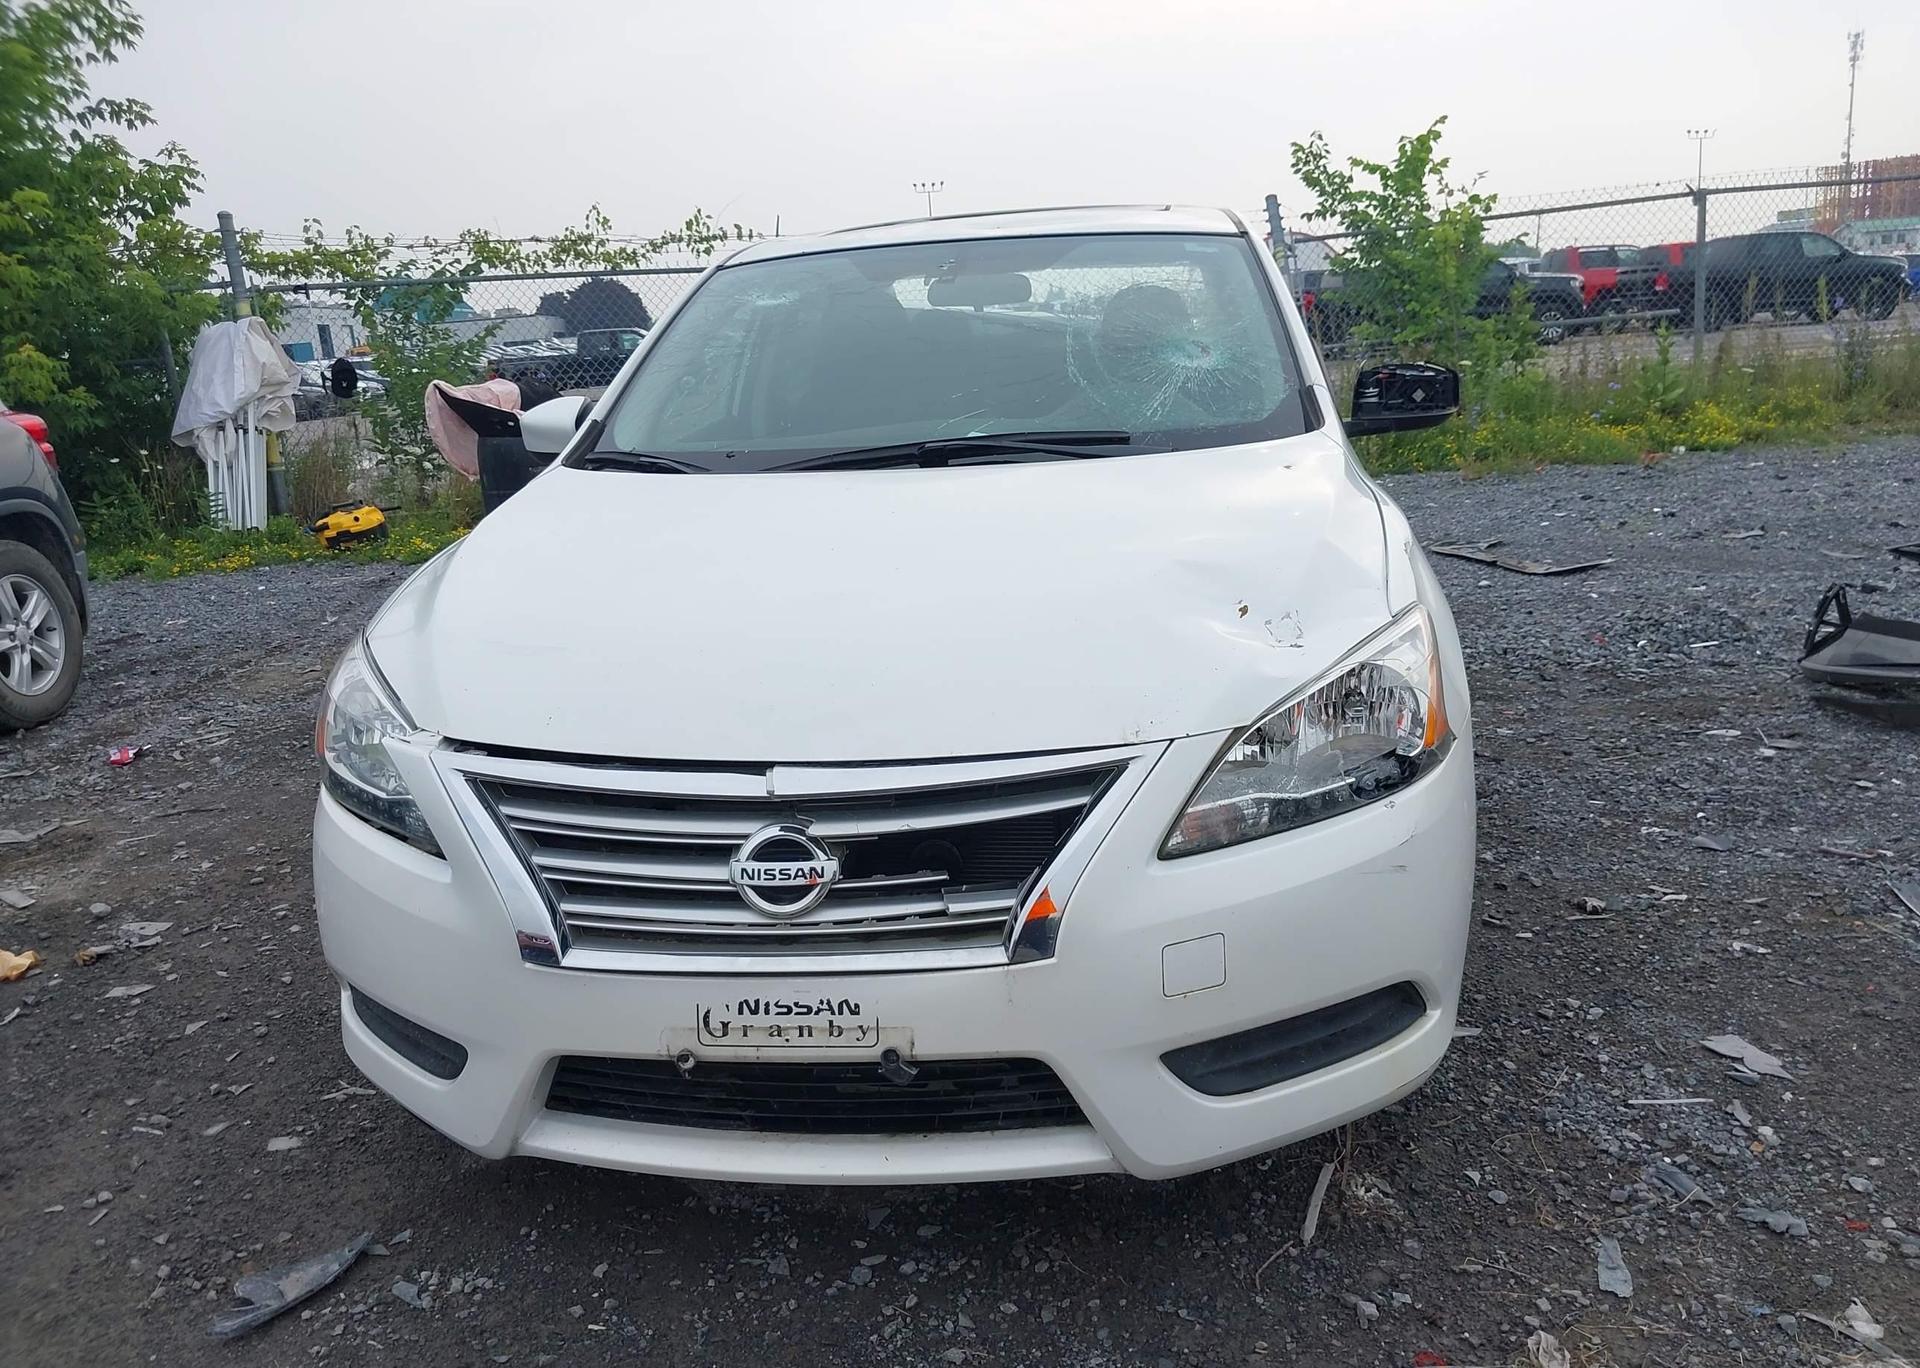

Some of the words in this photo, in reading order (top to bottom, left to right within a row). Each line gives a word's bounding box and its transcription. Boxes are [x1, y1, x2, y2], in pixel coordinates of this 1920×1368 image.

[740, 865, 825, 881] NISSAN
[737, 998, 861, 1016] NISSAN
[702, 1005, 870, 1042] Granby
